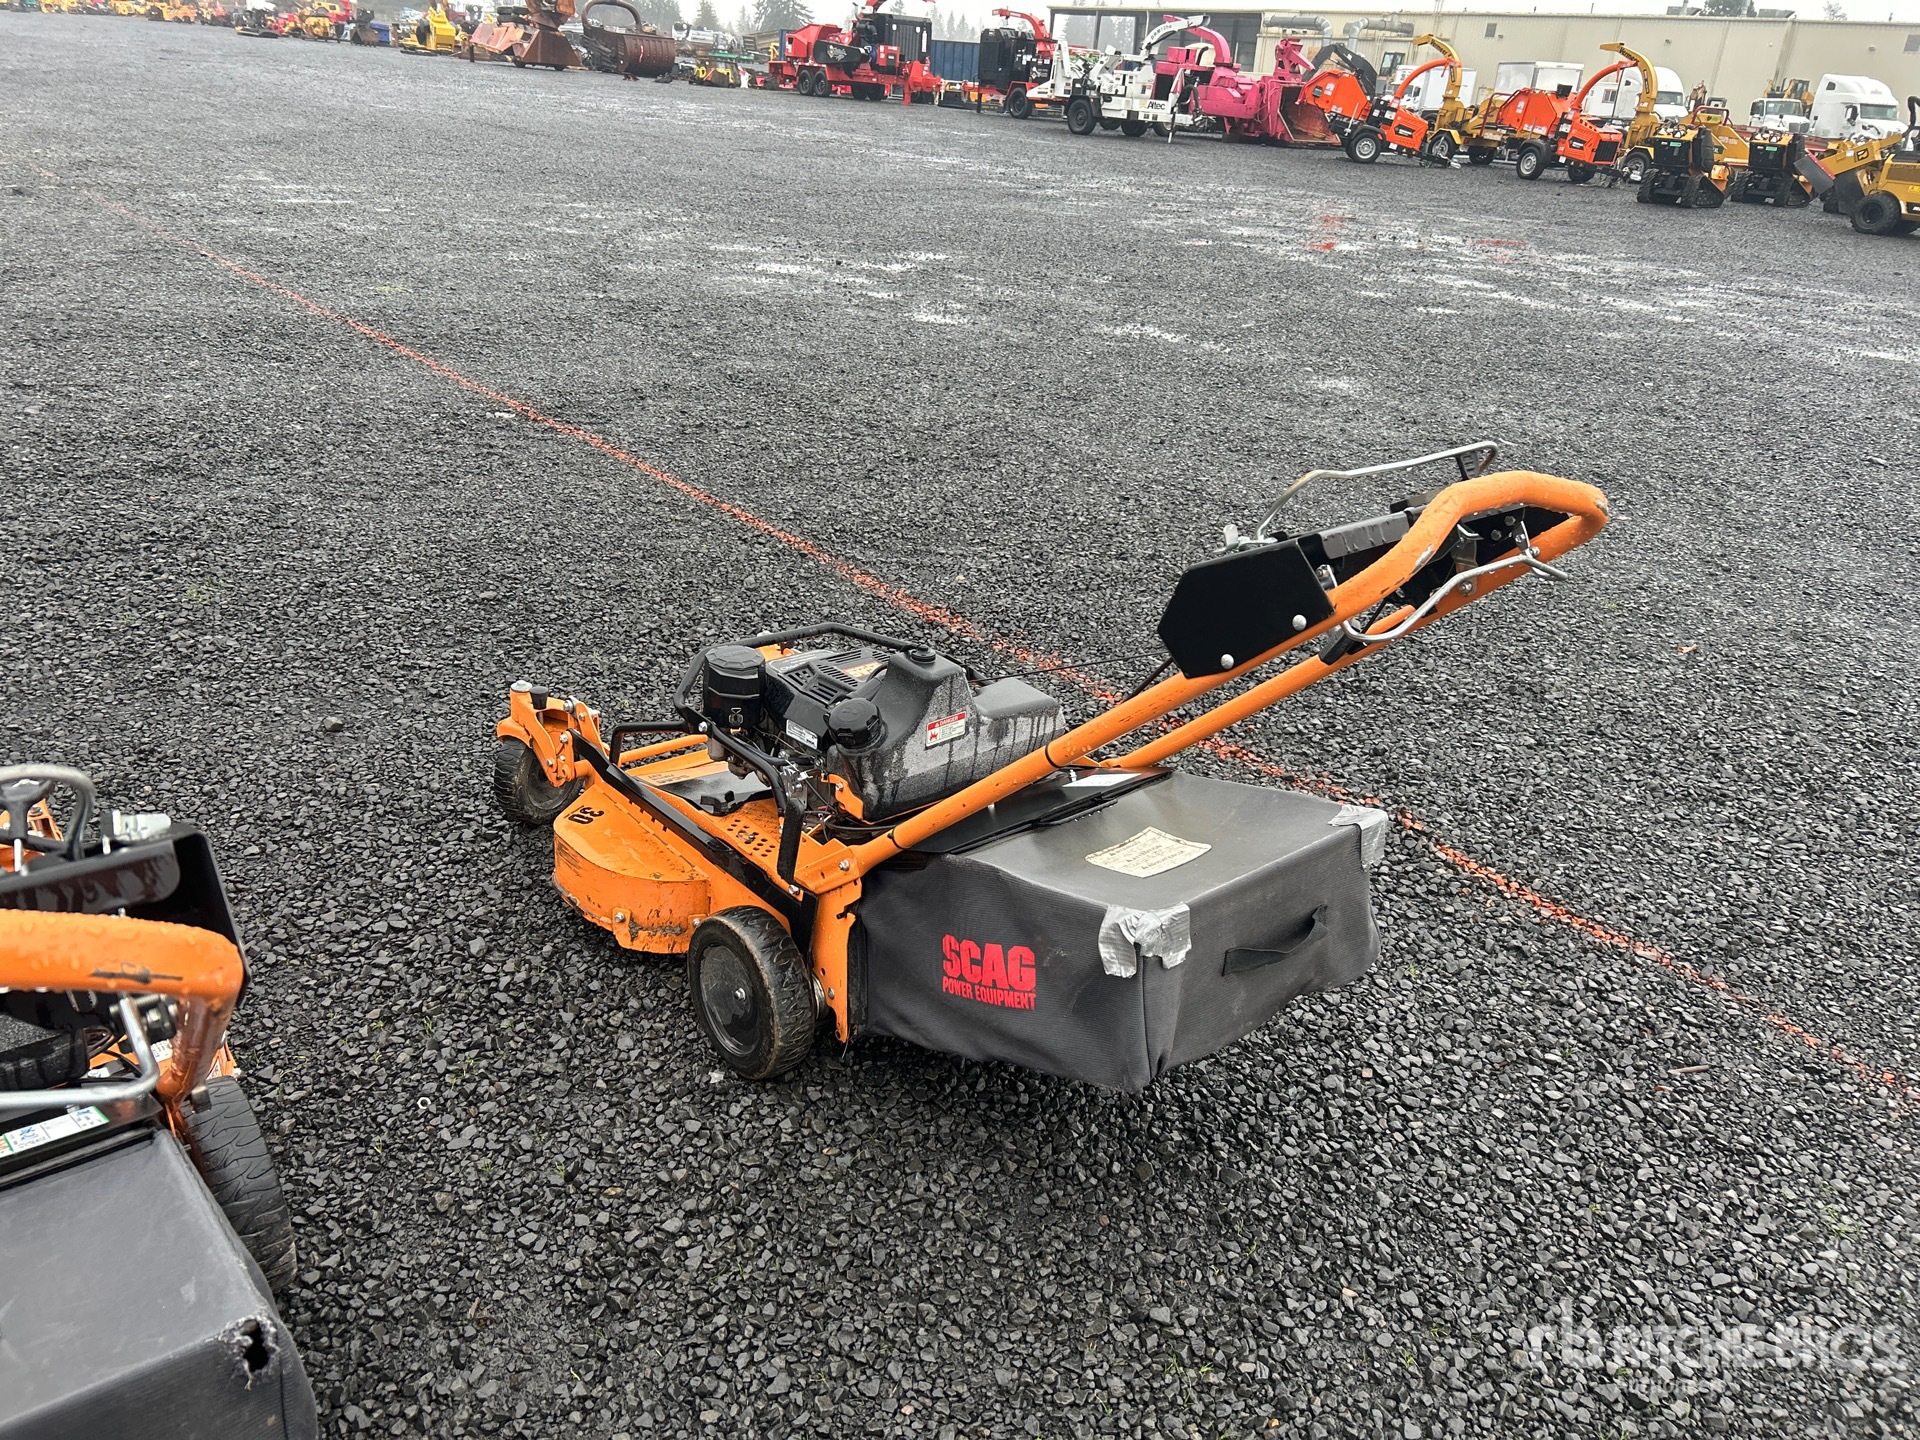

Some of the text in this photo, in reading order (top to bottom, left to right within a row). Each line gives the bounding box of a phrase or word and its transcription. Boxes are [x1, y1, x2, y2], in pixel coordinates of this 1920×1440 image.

[1147, 101, 1166, 110] Altec
[939, 715, 959, 726] DANGER
[568, 806, 605, 825] 30
[942, 933, 1037, 992] SCAG
[942, 975, 1036, 1010] POWER EQUIPMENT
